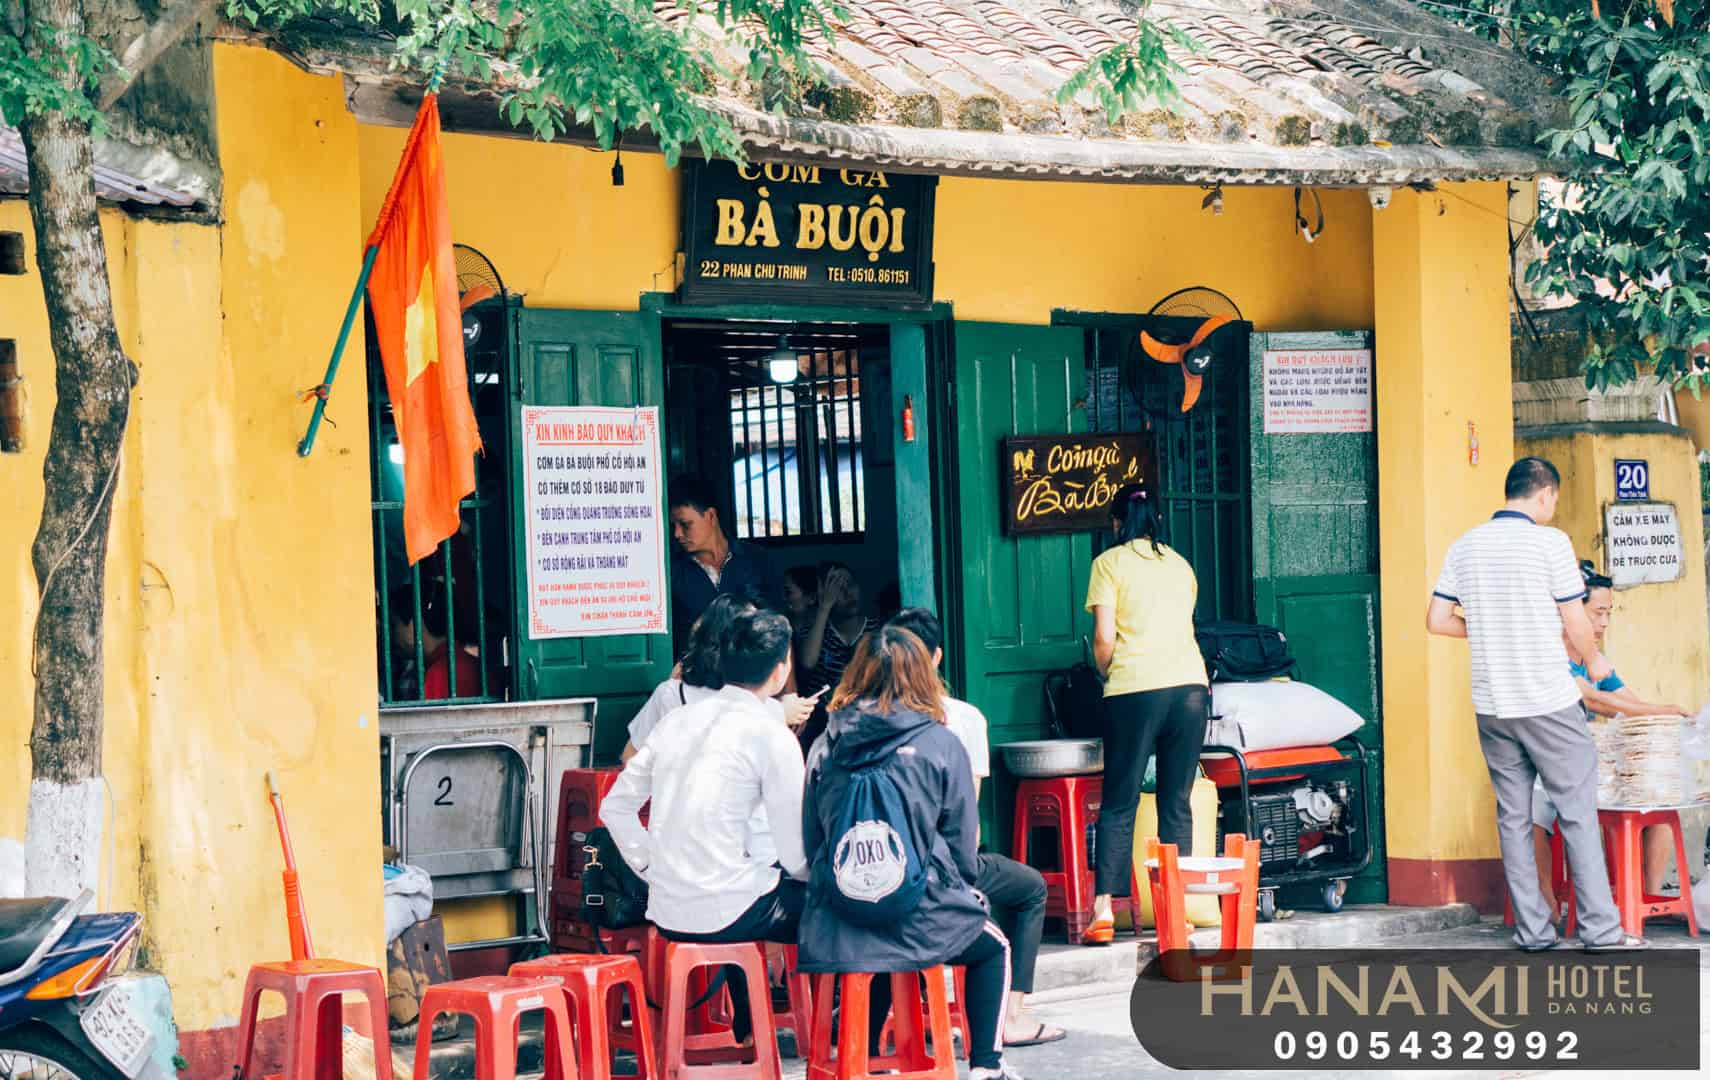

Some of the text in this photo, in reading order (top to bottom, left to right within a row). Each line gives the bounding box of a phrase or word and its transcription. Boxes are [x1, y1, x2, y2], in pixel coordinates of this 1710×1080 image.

[714, 186, 906, 262] BÀ BUỘI
[701, 260, 720, 278] 22
[723, 263, 751, 279] PHAN
[754, 264, 776, 279] CHU
[776, 264, 807, 280] TRINH
[536, 423, 550, 440] XIN
[637, 456, 646, 469] AN
[1619, 465, 1646, 489] 20
[1635, 515, 1649, 525] XE
[434, 776, 454, 806] 2
[856, 840, 885, 865] OXO
